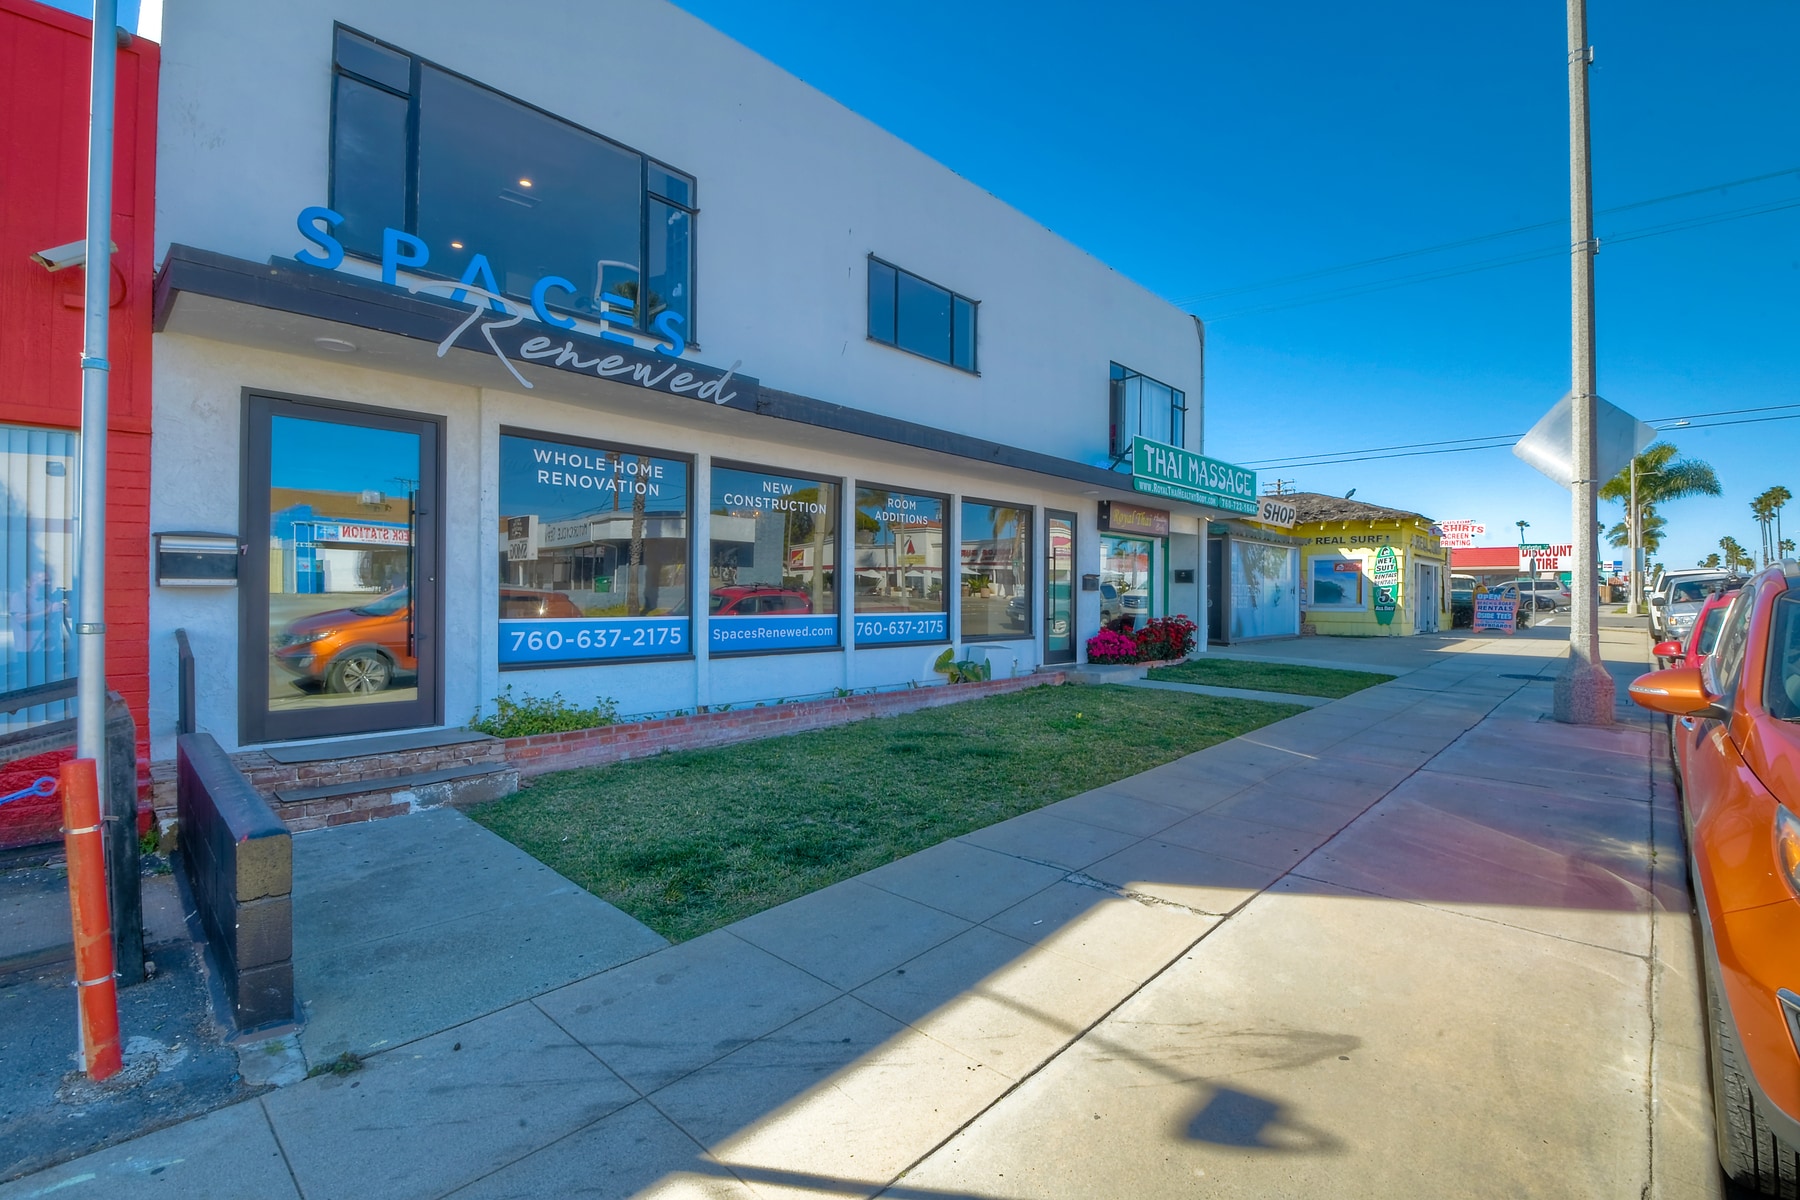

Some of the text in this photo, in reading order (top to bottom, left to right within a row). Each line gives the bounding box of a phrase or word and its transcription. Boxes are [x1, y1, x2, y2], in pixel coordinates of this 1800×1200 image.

[294, 206, 686, 358] SPACES
[408, 280, 742, 405] Renewed
[533, 449, 664, 479] WHOLE HOME
[1143, 443, 1252, 497] THAI MASSAGE
[537, 470, 660, 497] RENOVATION
[762, 481, 793, 496] NEW
[723, 493, 827, 516] CONSTRUCTION
[887, 498, 916, 511] ROOM
[1263, 502, 1295, 524] SHOP
[874, 510, 928, 525] ADDITIONS
[1113, 509, 1136, 528] Royal
[1136, 511, 1153, 527] Thai
[1442, 524, 1484, 533] SHIRTS
[1315, 535, 1383, 545] REAL SURF
[1376, 564, 1395, 572] SUIT
[1377, 556, 1394, 564] WET
[1536, 558, 1559, 569] TIRE
[712, 626, 833, 642] SpacesRenewed.com
[856, 619, 944, 637] 760-637-2175
[511, 627, 682, 652] 760-637-2175
